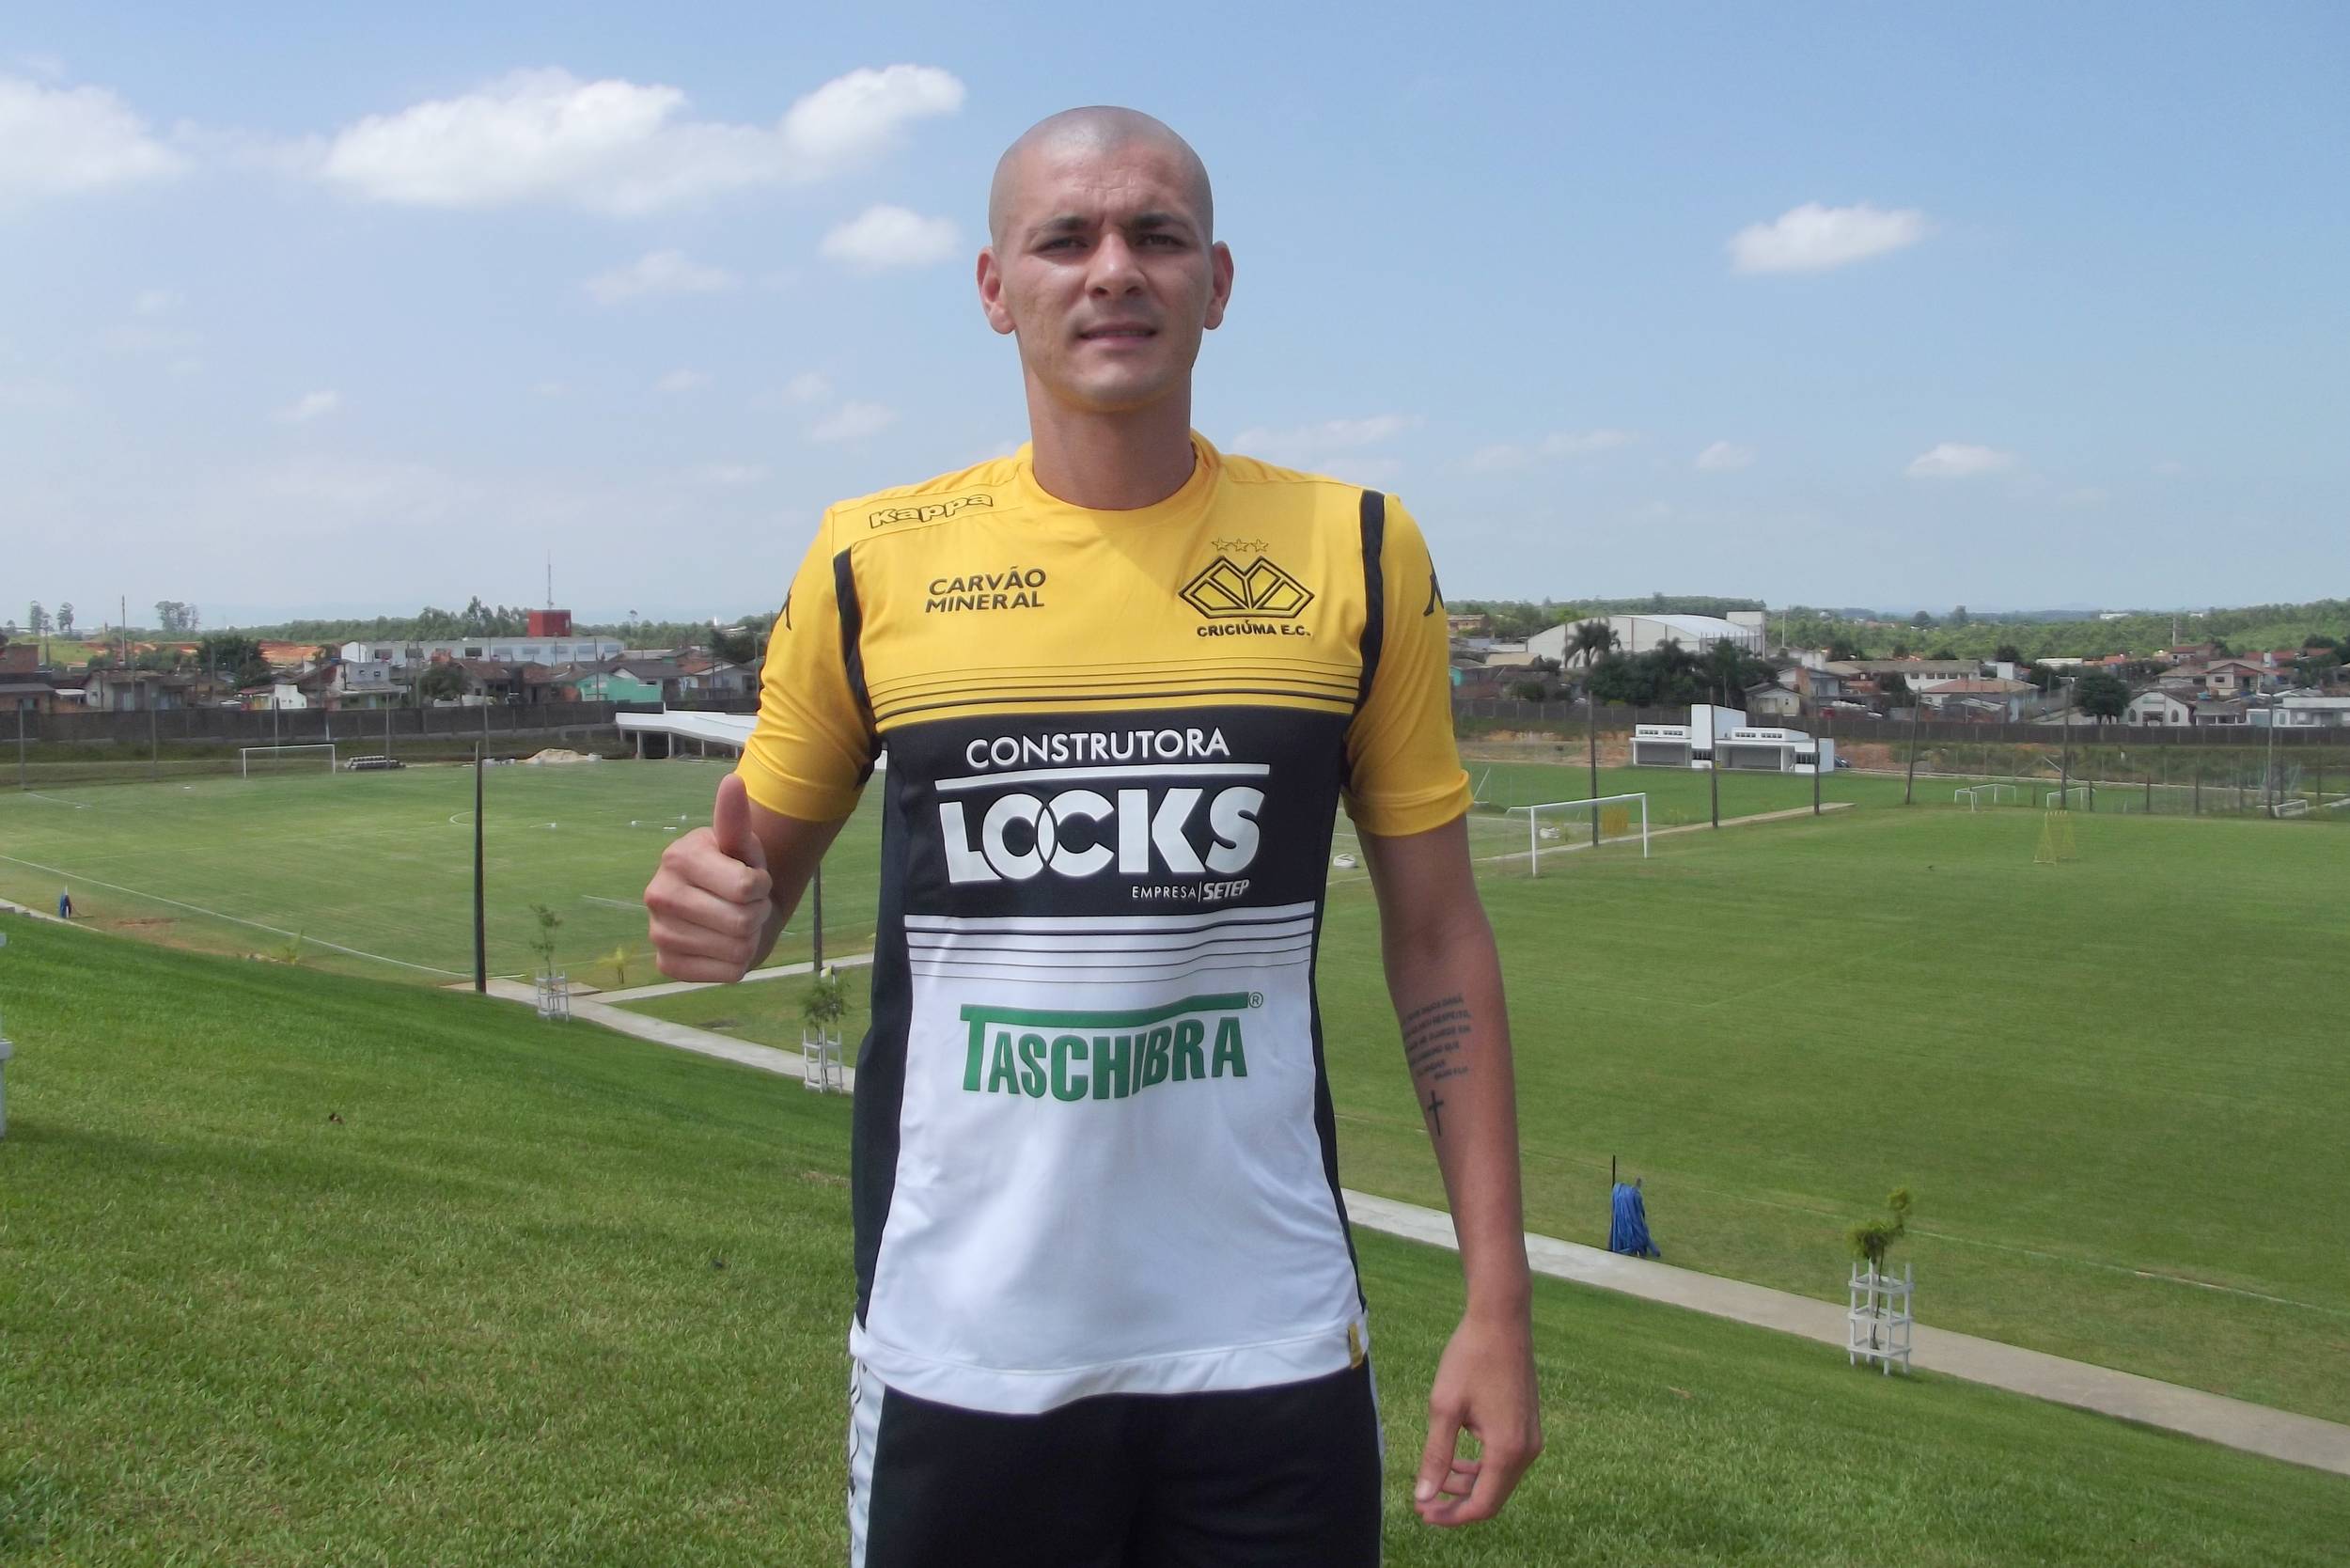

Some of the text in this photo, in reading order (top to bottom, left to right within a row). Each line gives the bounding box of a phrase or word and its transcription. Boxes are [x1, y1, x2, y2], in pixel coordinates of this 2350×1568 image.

[869, 494, 994, 528] Kappa
[929, 566, 1046, 596] CARVÃO
[925, 590, 1045, 613] MINERAL
[1197, 619, 1311, 637] CRICIÚMA E.C.
[965, 727, 1230, 768] CONSTRUTORA
[938, 786, 1265, 884] LOCKS
[1132, 879, 1250, 901] EMPRESA SETEP
[959, 991, 1249, 1102] TASCHIBRA
